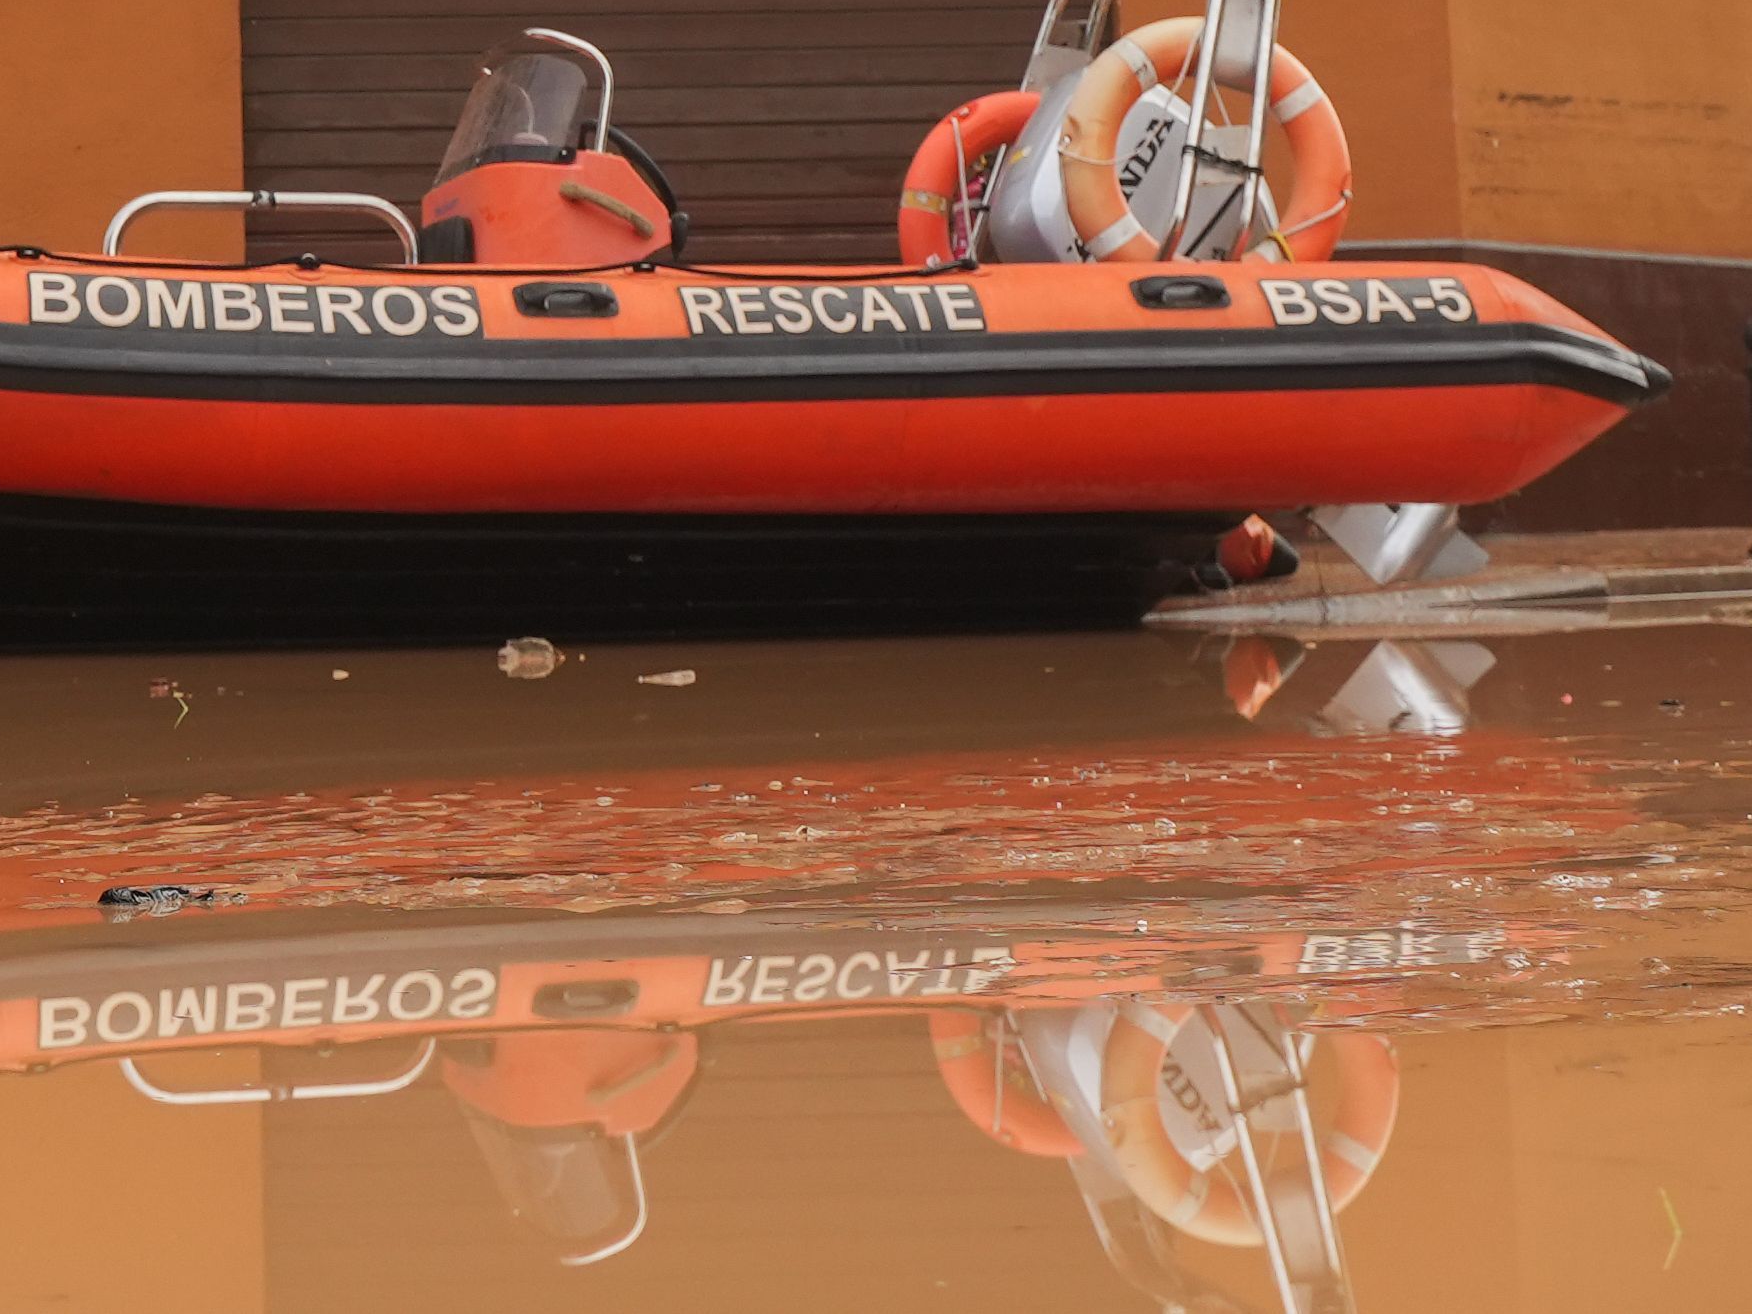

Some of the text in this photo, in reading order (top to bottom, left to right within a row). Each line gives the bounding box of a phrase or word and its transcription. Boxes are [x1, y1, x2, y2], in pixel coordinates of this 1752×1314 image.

[29, 272, 1472, 336] BOMBEROS RESCATE BSA-5
